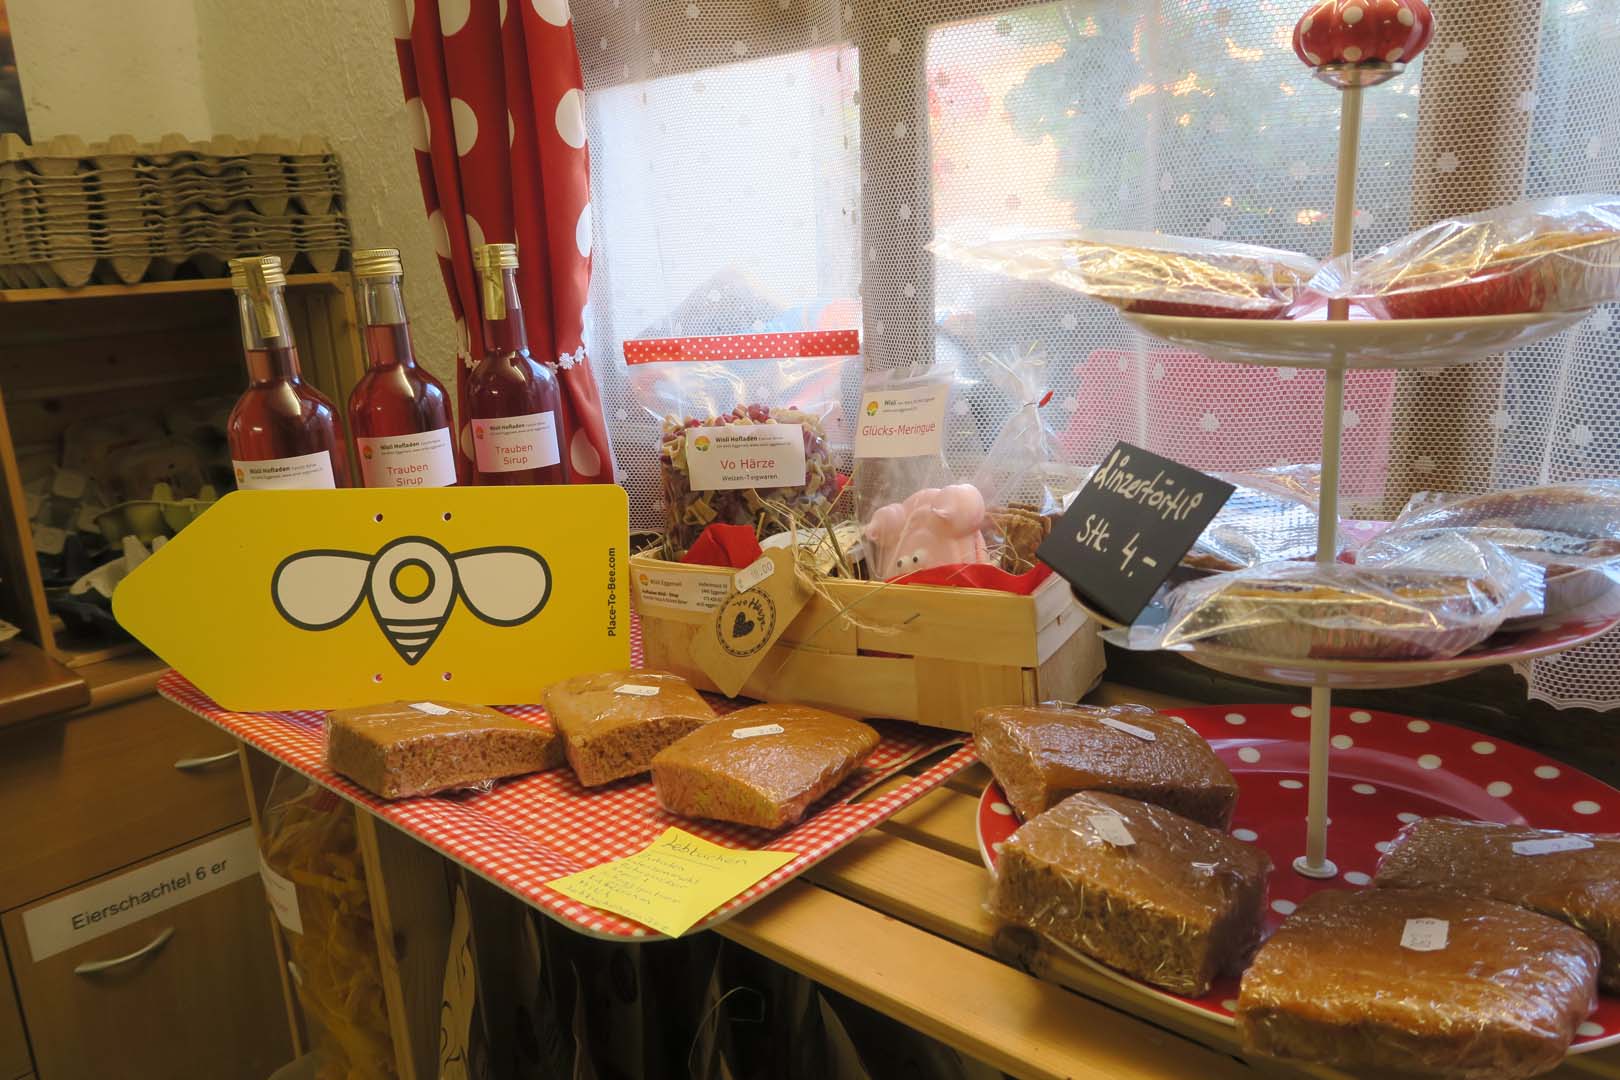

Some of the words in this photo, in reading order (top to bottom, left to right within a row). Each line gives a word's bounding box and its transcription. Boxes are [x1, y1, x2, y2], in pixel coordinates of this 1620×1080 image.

[862, 423, 936, 437] Glücks-Meringue
[495, 444, 533, 455] Trauben
[503, 457, 528, 465] Sirup
[720, 460, 736, 470] Vo
[740, 459, 776, 469] Härze
[386, 464, 430, 476] Trauben
[396, 476, 424, 487] Sirup
[721, 474, 778, 483] Weizen-Teigwaren
[607, 547, 616, 637] Place-To-Bee.com
[71, 871, 192, 931] Eierschachtel
[195, 866, 207, 881] 6
[210, 859, 228, 875] er
